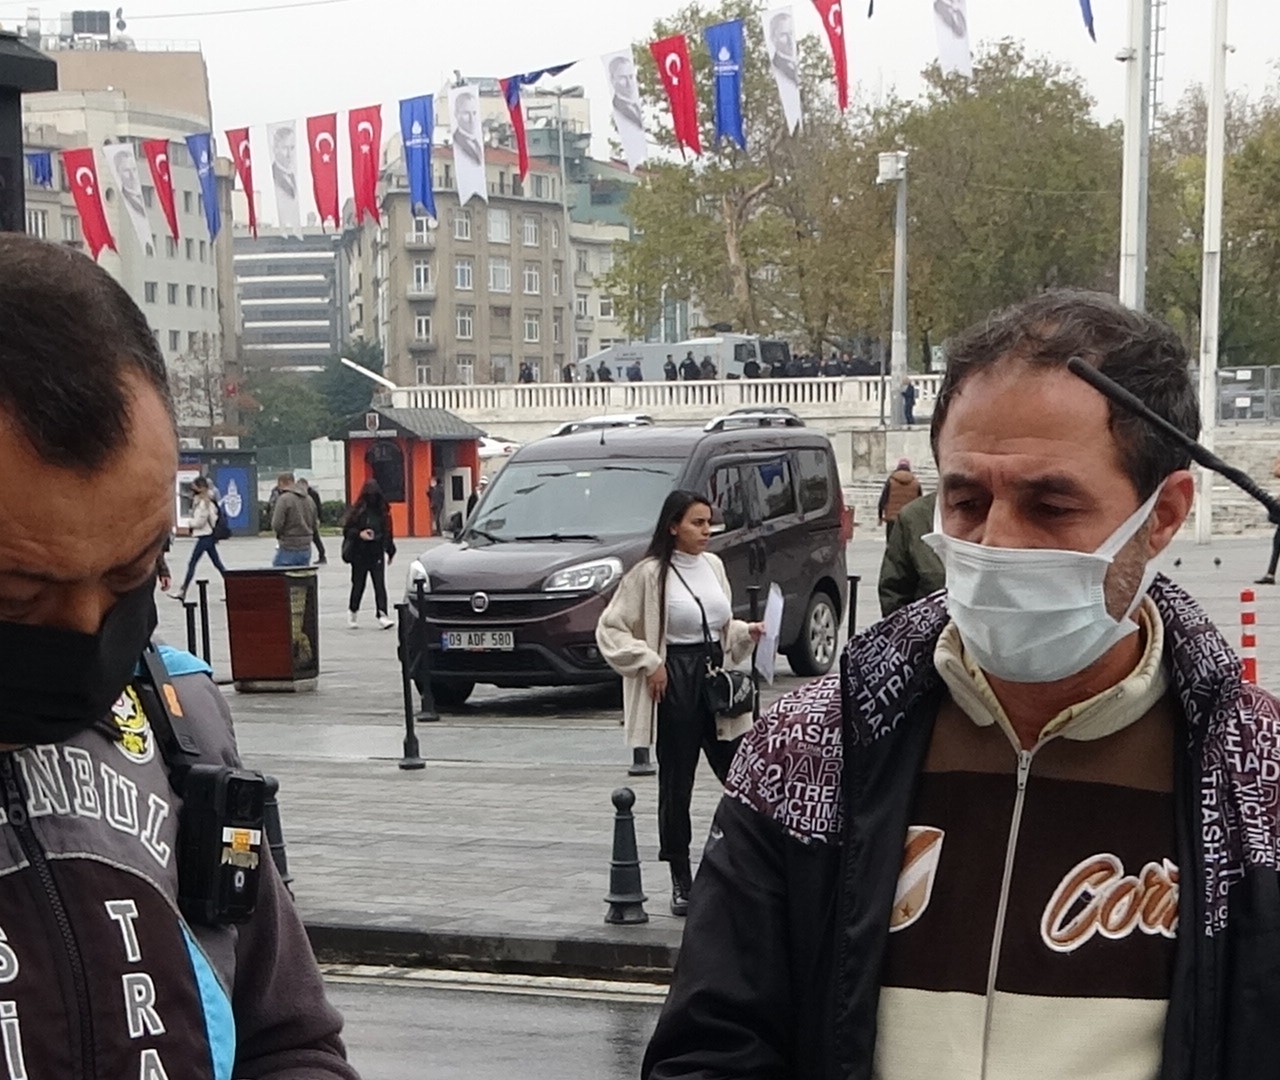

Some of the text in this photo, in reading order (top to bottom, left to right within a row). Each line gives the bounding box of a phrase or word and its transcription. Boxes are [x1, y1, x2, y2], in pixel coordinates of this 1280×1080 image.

[449, 632, 511, 646] 09 ADF 580
